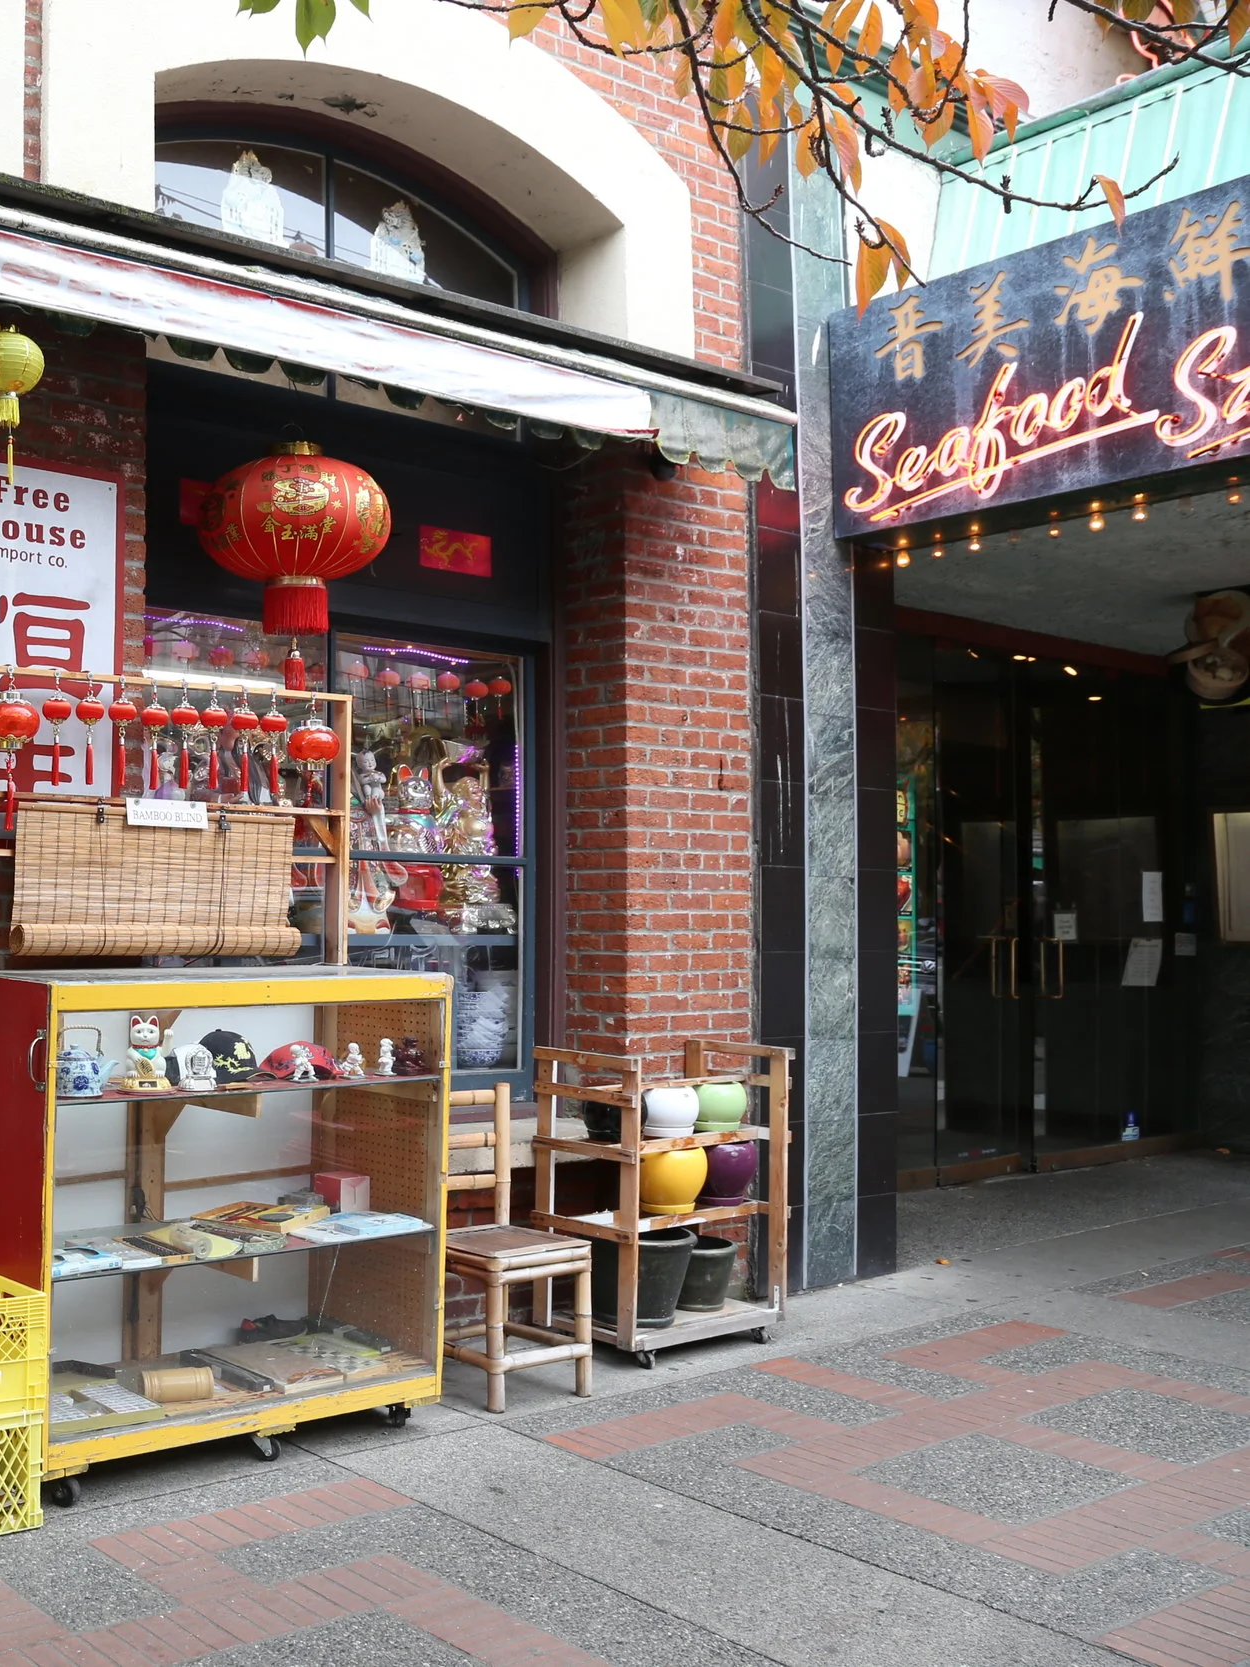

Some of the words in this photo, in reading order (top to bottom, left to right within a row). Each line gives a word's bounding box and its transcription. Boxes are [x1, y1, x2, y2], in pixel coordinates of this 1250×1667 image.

[844, 311, 1147, 499] Seafood
[48, 555, 68, 569] co.
[132, 809, 173, 822] BAMBOO
[175, 812, 203, 823] BLIND
